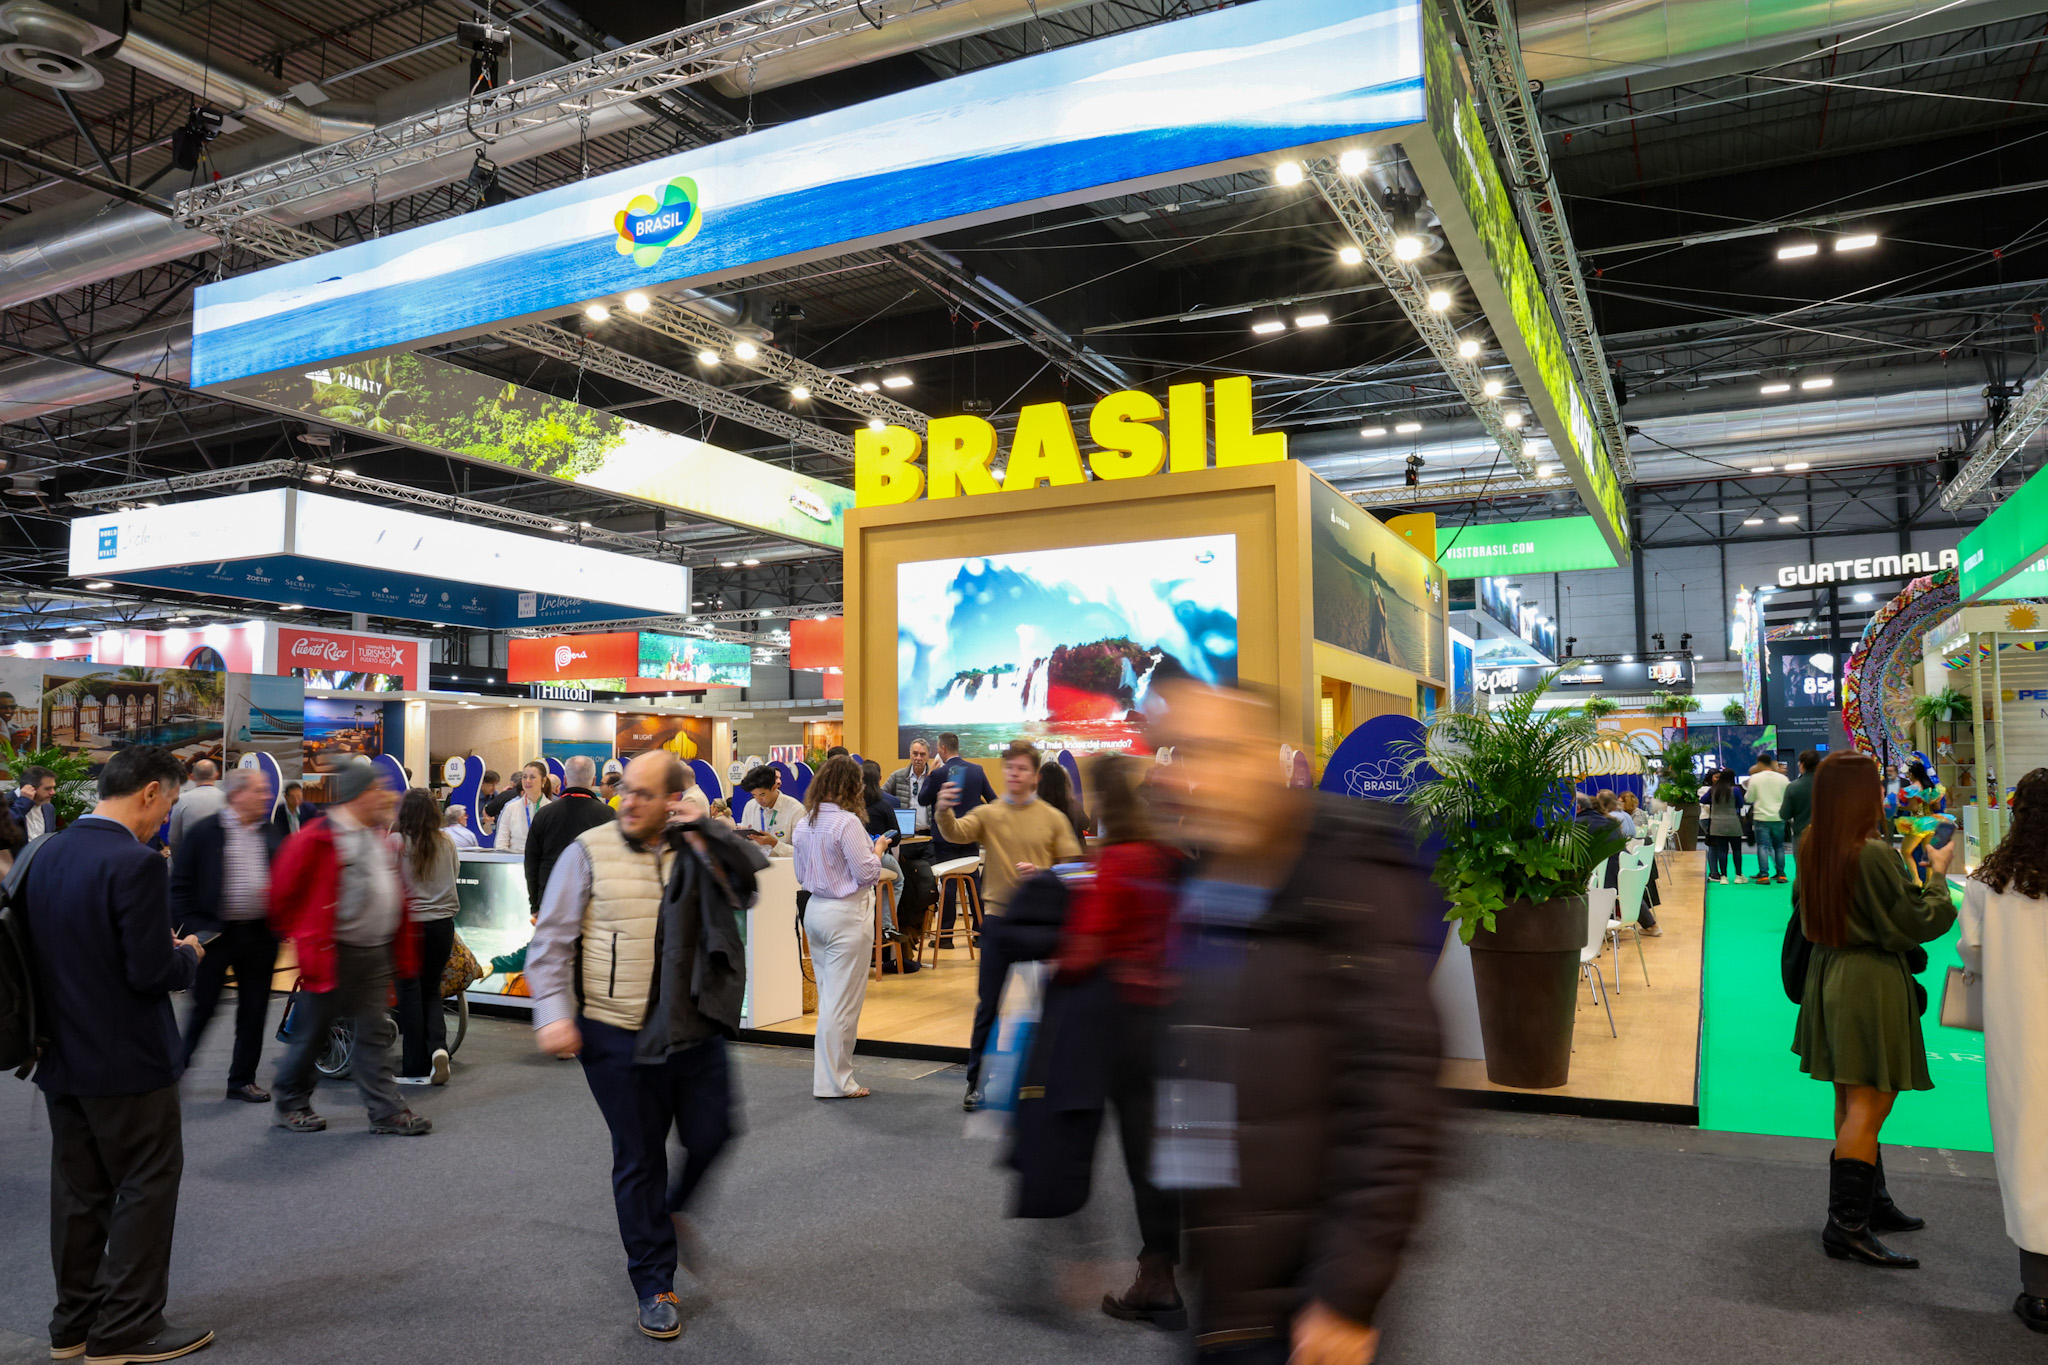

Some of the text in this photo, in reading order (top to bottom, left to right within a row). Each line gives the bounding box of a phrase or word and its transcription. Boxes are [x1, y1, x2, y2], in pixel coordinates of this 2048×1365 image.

[636, 211, 684, 237] BRASIL
[339, 371, 382, 396] PARATY
[854, 375, 1288, 508] BRASIL
[1446, 542, 1535, 560] VISITBRASIL.COM
[1778, 549, 1959, 587] GUATEMALA
[541, 609, 581, 617] COLLECTION
[291, 637, 350, 662] Puerto Rico
[358, 647, 391, 659] TURISMO
[360, 656, 379, 664] PUERTO
[542, 685, 588, 702] Hilton
[639, 733, 653, 741] LIGHT
[1101, 739, 1132, 749] mundo?
[244, 760, 253, 769] 01
[451, 763, 459, 771] 03
[1363, 781, 1403, 791] BRASIL
